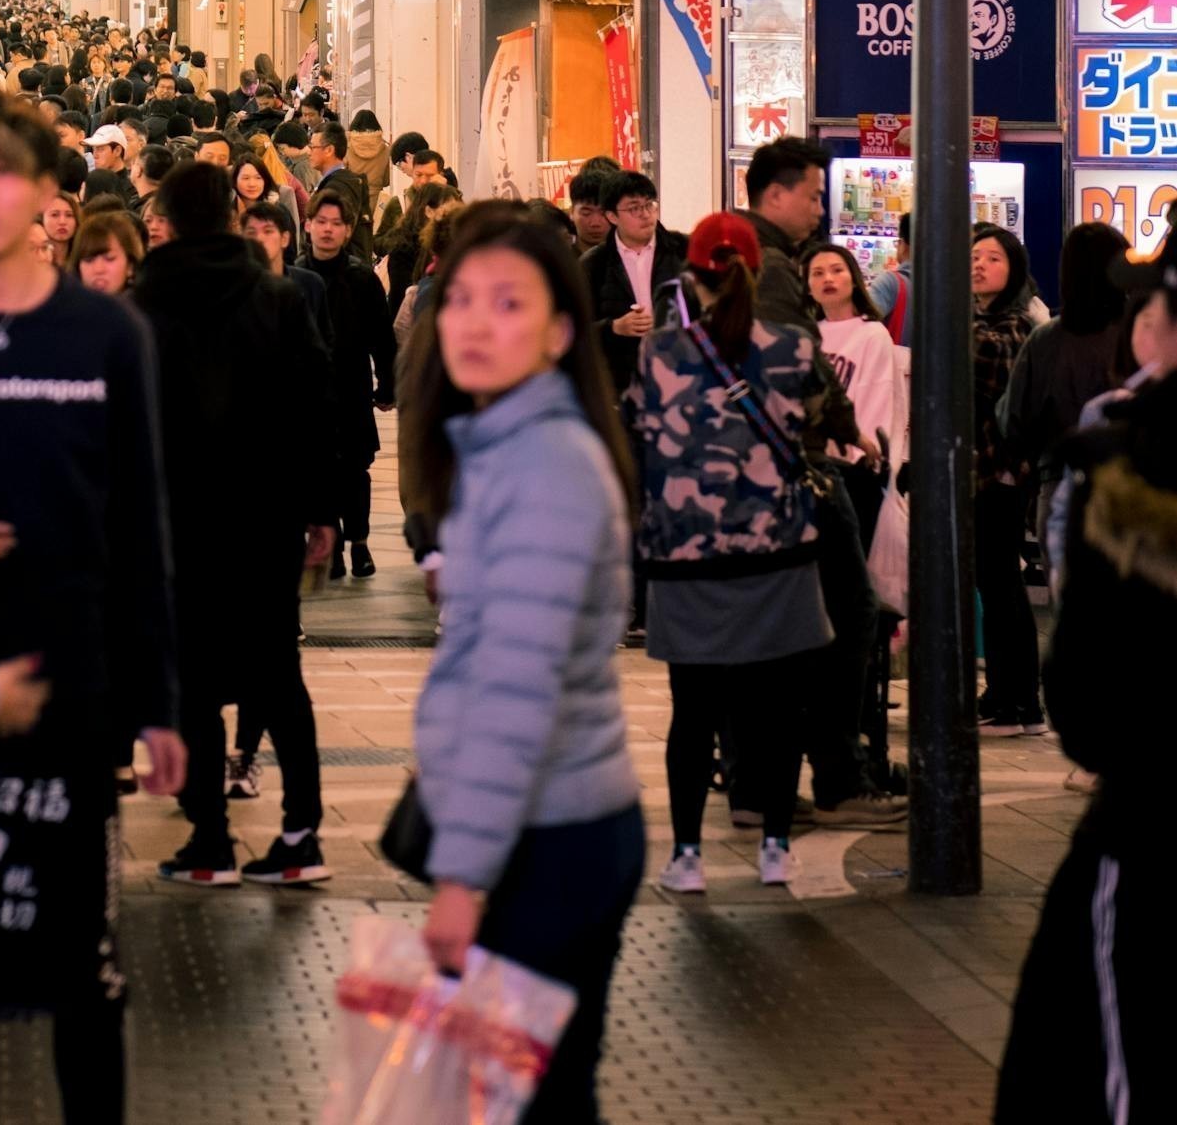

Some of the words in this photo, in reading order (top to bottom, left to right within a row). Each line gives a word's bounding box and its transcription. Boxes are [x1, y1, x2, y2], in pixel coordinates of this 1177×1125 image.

[856, 2, 916, 37] BOS
[867, 40, 913, 56] COFF
[1081, 51, 1177, 110] ダイ
[865, 131, 890, 146] 551
